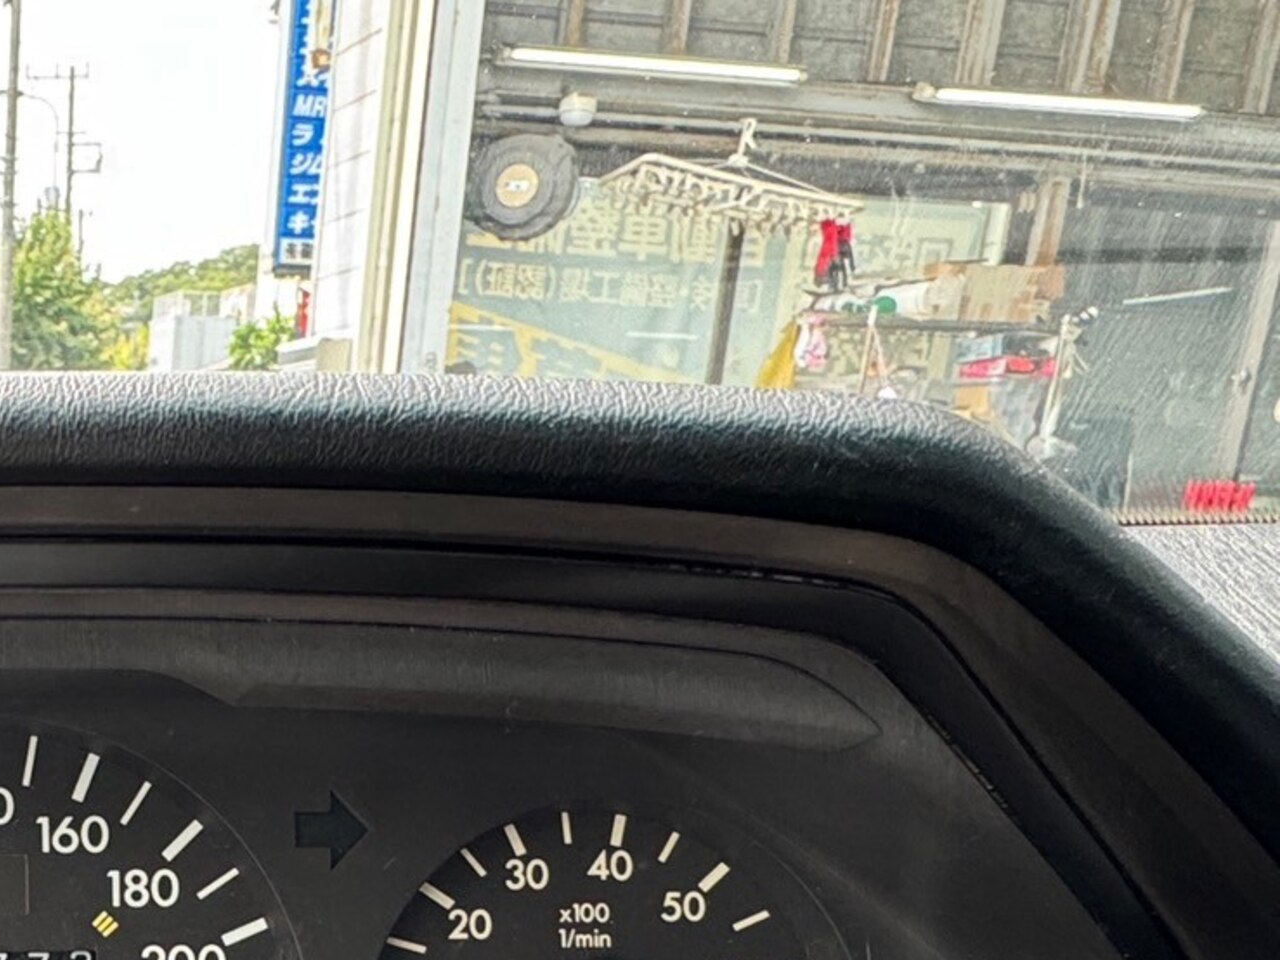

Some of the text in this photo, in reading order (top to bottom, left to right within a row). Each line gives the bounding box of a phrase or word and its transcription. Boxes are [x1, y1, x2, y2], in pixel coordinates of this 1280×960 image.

[36, 815, 109, 854] 160
[505, 858, 549, 890] 30
[587, 850, 633, 881] 40
[107, 868, 179, 908] 180
[659, 890, 707, 923] 50
[448, 909, 492, 940] 20
[558, 927, 613, 949] 1/min
